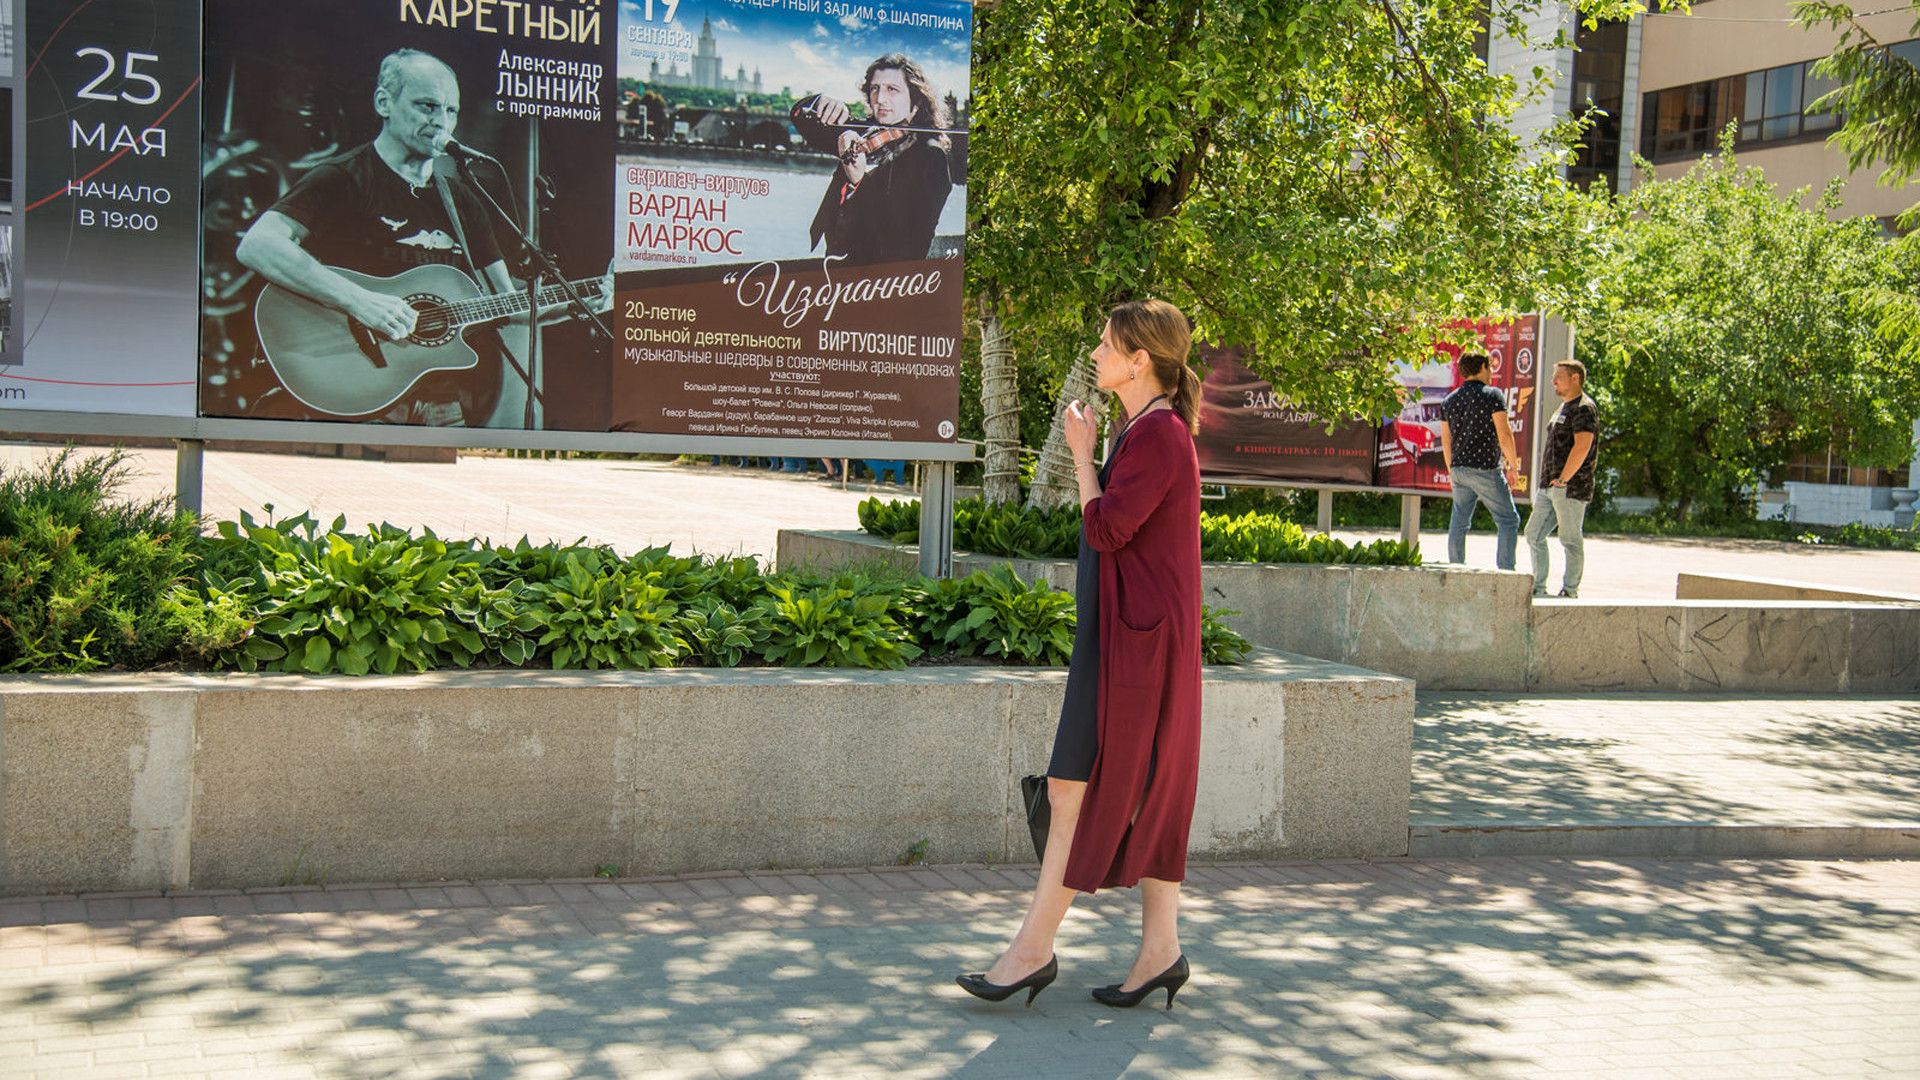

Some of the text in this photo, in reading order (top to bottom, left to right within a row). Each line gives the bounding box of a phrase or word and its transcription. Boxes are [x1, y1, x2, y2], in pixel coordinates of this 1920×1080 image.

[400, 0, 600, 45] КАРЕТНЫЙ
[824, 1, 849, 17] ЗАЛ
[628, 25, 693, 48] СЕНТЯБРЯ
[76, 47, 161, 105] 25
[498, 49, 603, 83] Александр
[496, 71, 600, 106] ЛЫННИК
[496, 100, 601, 122] с программой
[72, 119, 166, 158] МАЯ
[67, 180, 172, 205] НАЧАЛО
[627, 167, 770, 200] скрипач-виртуоз
[80, 209, 159, 232] В 19:00
[628, 191, 727, 225] ВАРДАН
[627, 221, 743, 255] МАРКОС
[629, 250, 697, 265] vardanmarkos.ru
[624, 300, 697, 322] 20-летие
[624, 327, 801, 351] сольной деятельности
[818, 329, 956, 358] ВИРТУОЗНОЕ ШОУ
[624, 347, 955, 379] музыкальные шедевры в современных аранжировках
[769, 371, 821, 383] участвуют:
[0, 386, 26, 401] m
